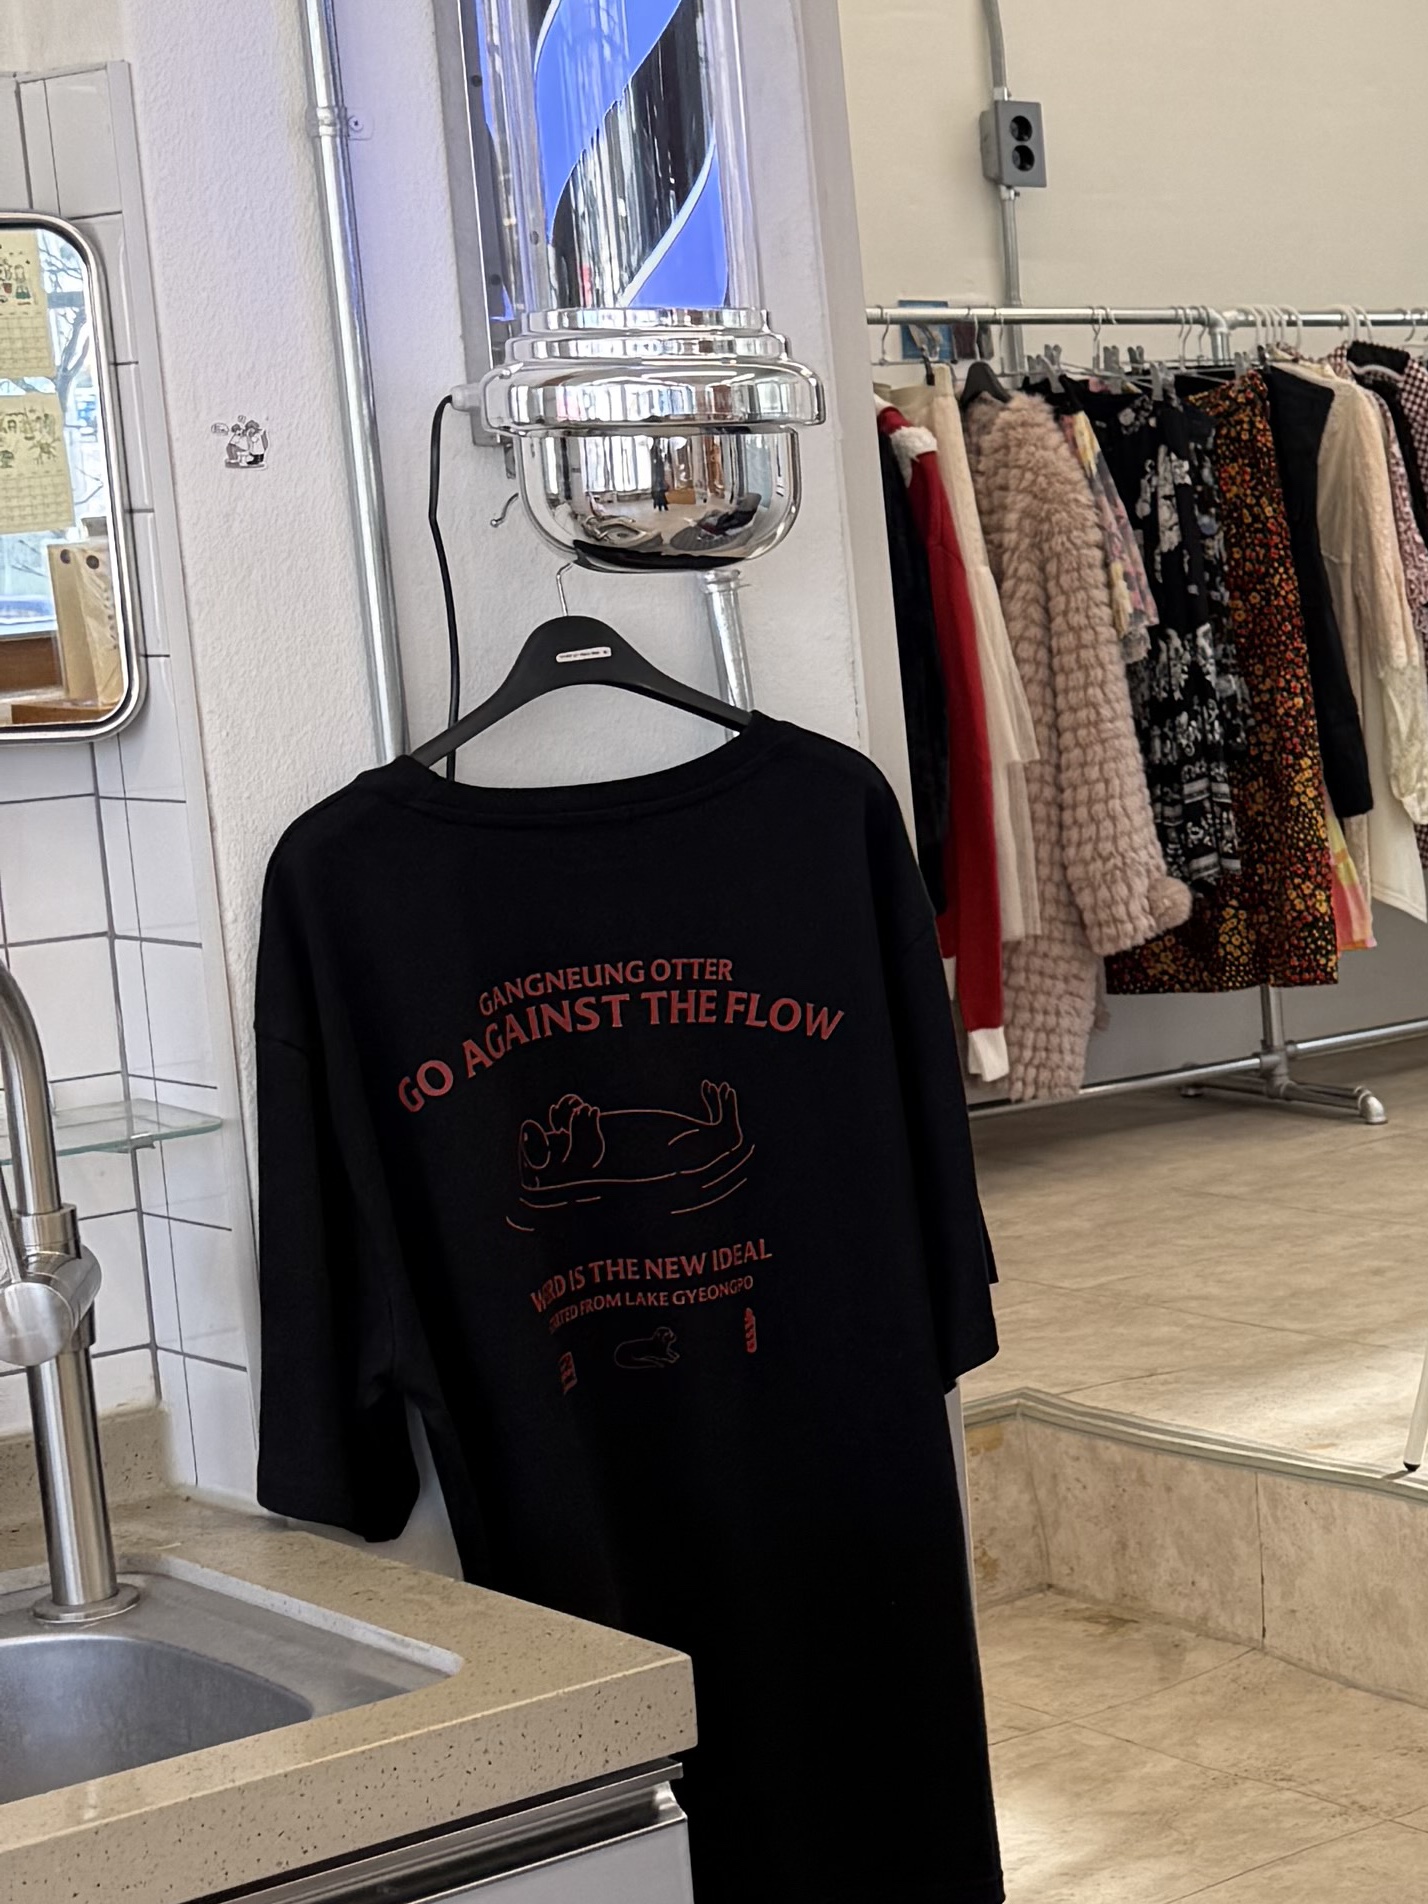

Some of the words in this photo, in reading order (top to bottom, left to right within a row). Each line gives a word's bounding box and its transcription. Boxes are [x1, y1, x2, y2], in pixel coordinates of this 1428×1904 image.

[478, 959, 645, 1017] GANGNEUNG
[650, 958, 733, 983] OTTER
[398, 1059, 454, 1113] GO
[462, 994, 630, 1079] AGAINST
[641, 990, 718, 1025] THE
[724, 991, 845, 1041] FLOW
[568, 1266, 586, 1291] IS
[588, 1258, 640, 1284] THE
[645, 1252, 708, 1280] NEW
[712, 1238, 773, 1272] IDEAL
[580, 1293, 621, 1315] FROM
[625, 1291, 669, 1307] LAKE
[672, 1275, 754, 1306] GYEONGPO
